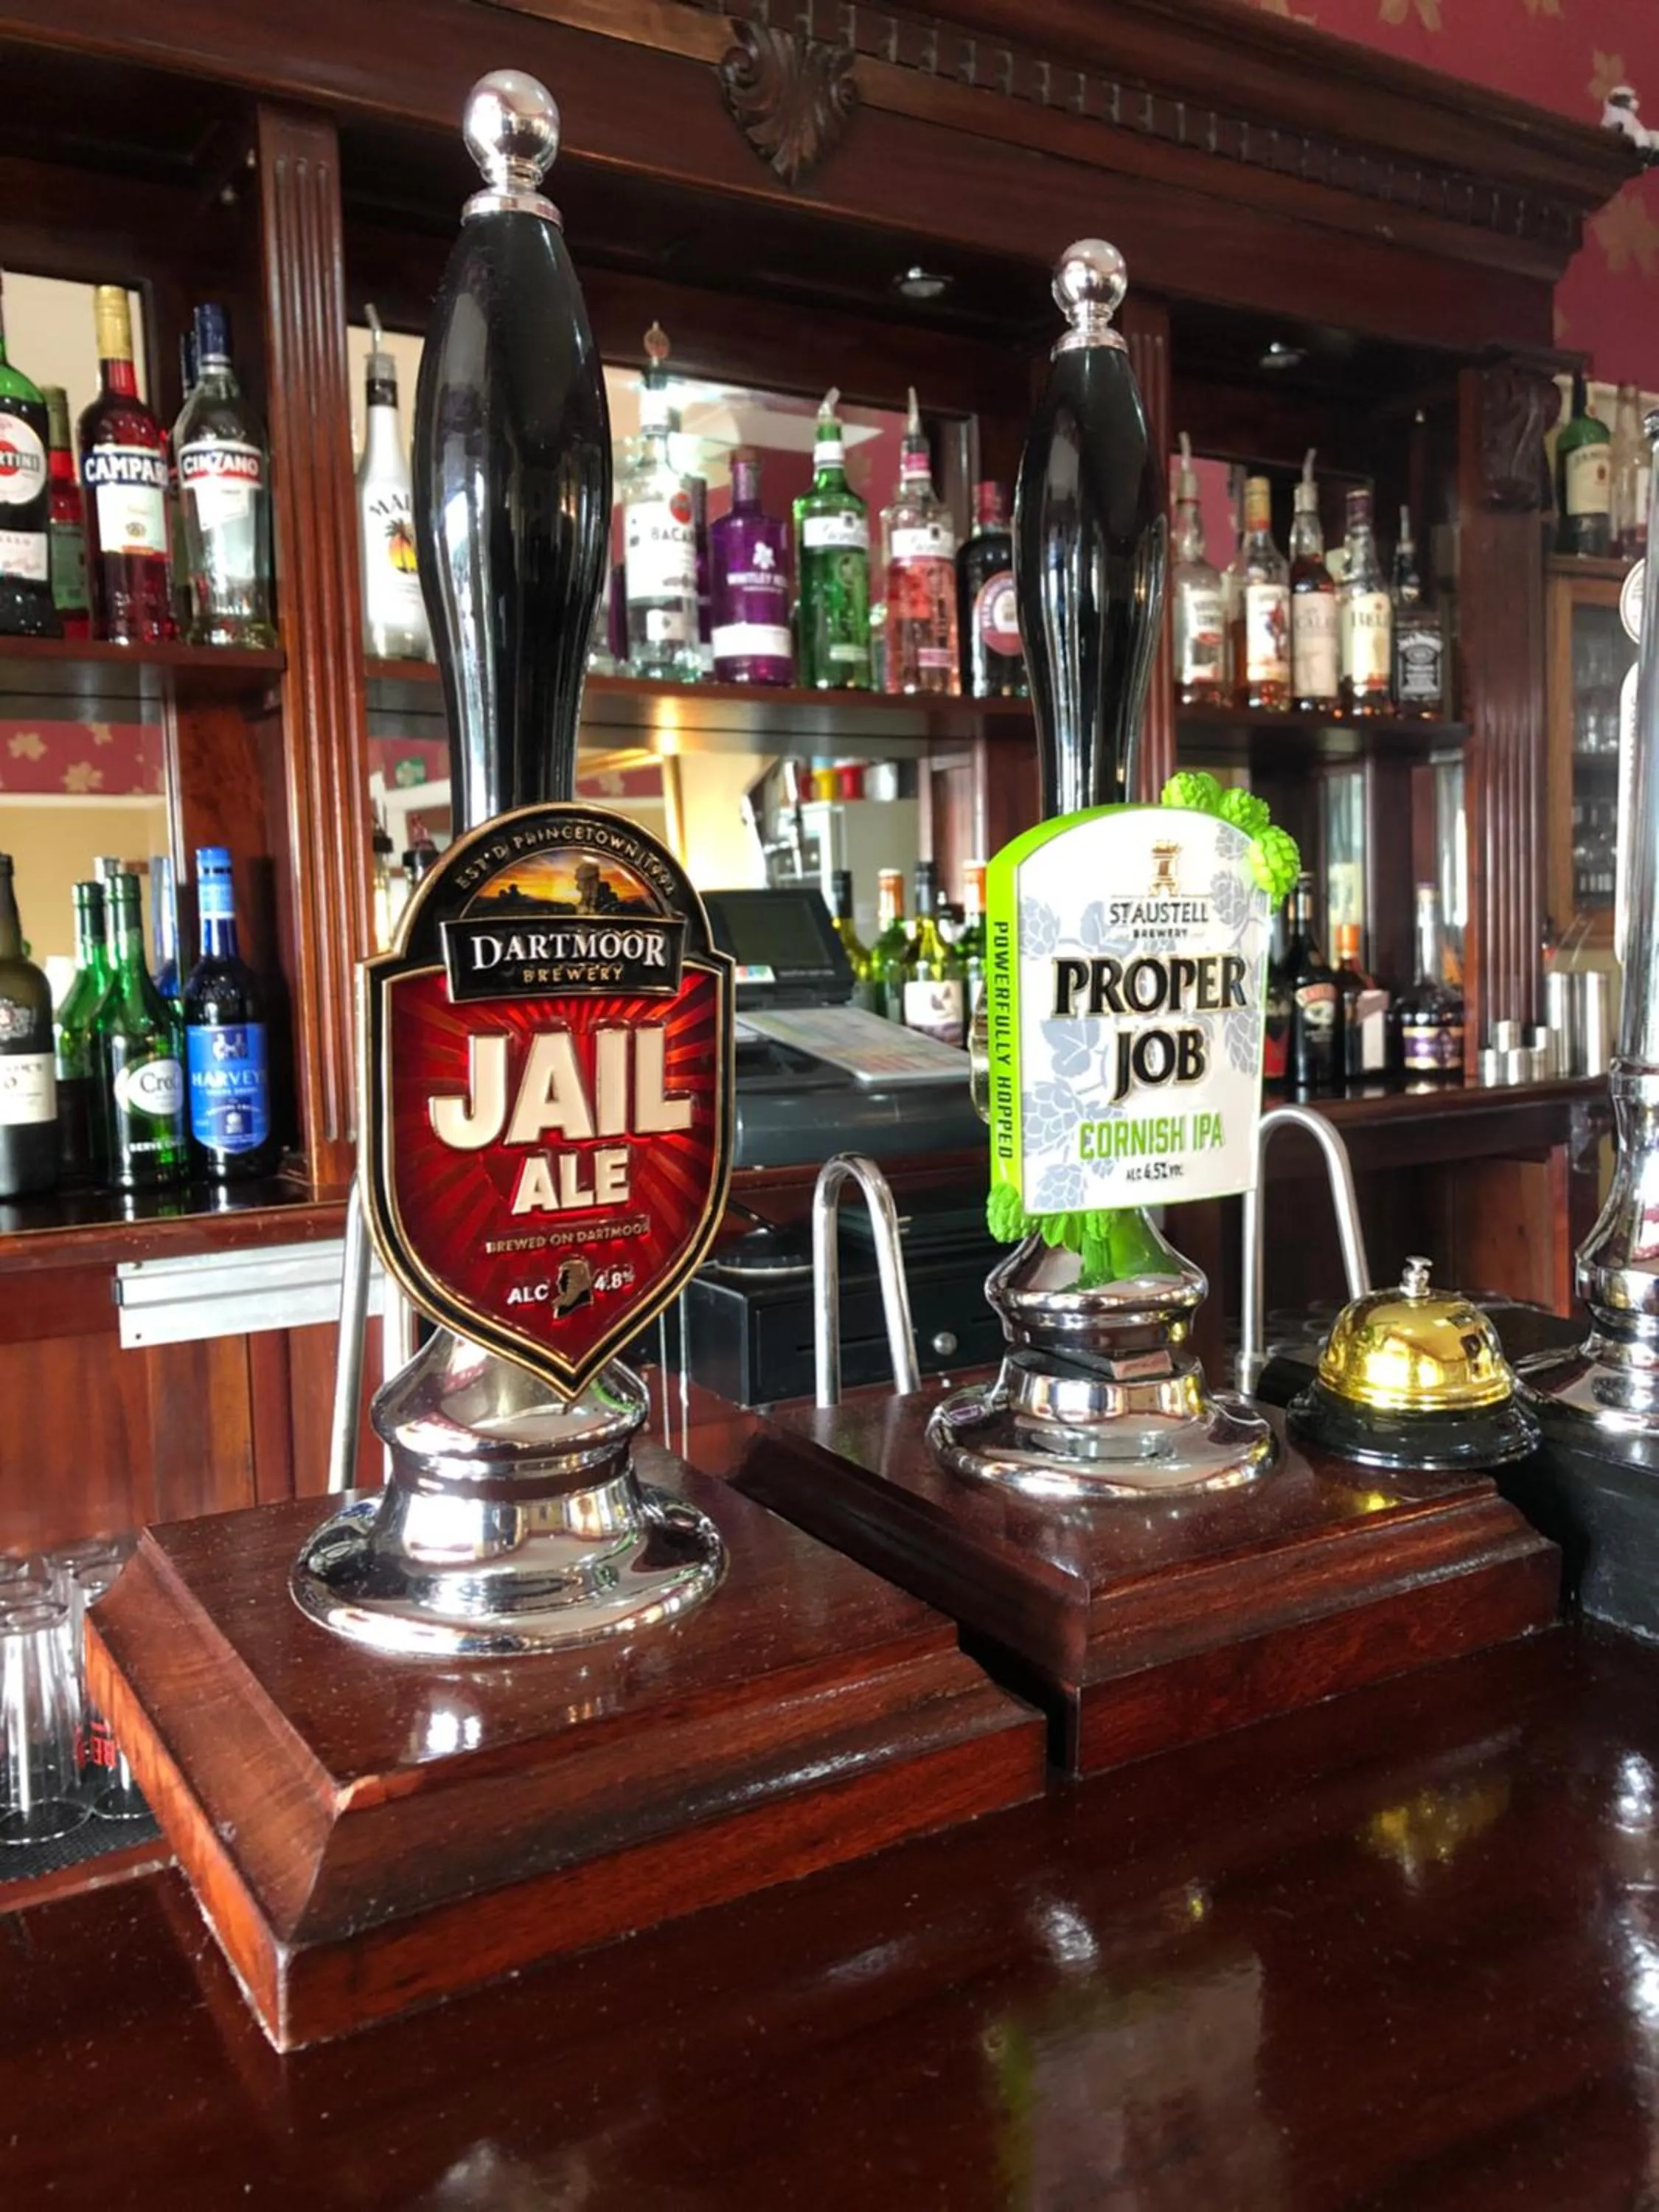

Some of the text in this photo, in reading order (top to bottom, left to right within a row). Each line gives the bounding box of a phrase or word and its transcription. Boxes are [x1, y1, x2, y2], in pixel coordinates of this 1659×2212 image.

[183, 451, 259, 476] CINZANO
[512, 825, 638, 858] PRINCETOWN
[470, 932, 666, 970] DARTMOOR
[1133, 928, 1188, 939] BREWERY
[523, 965, 624, 984] BREWERY
[1054, 957, 1248, 1017] PROPER
[994, 922, 1013, 1159] POWERFULLY HOPPED
[192, 1070, 264, 1088] HARVEY
[1108, 1028, 1207, 1104] JOB
[428, 1026, 693, 1150] JAIL
[1079, 1112, 1225, 1160] CORNISH IPA
[512, 1147, 630, 1215] ALE
[485, 1222, 650, 1253] BREWED ON DARTMOOR
[507, 1270, 635, 1305] ALC 4.8%
